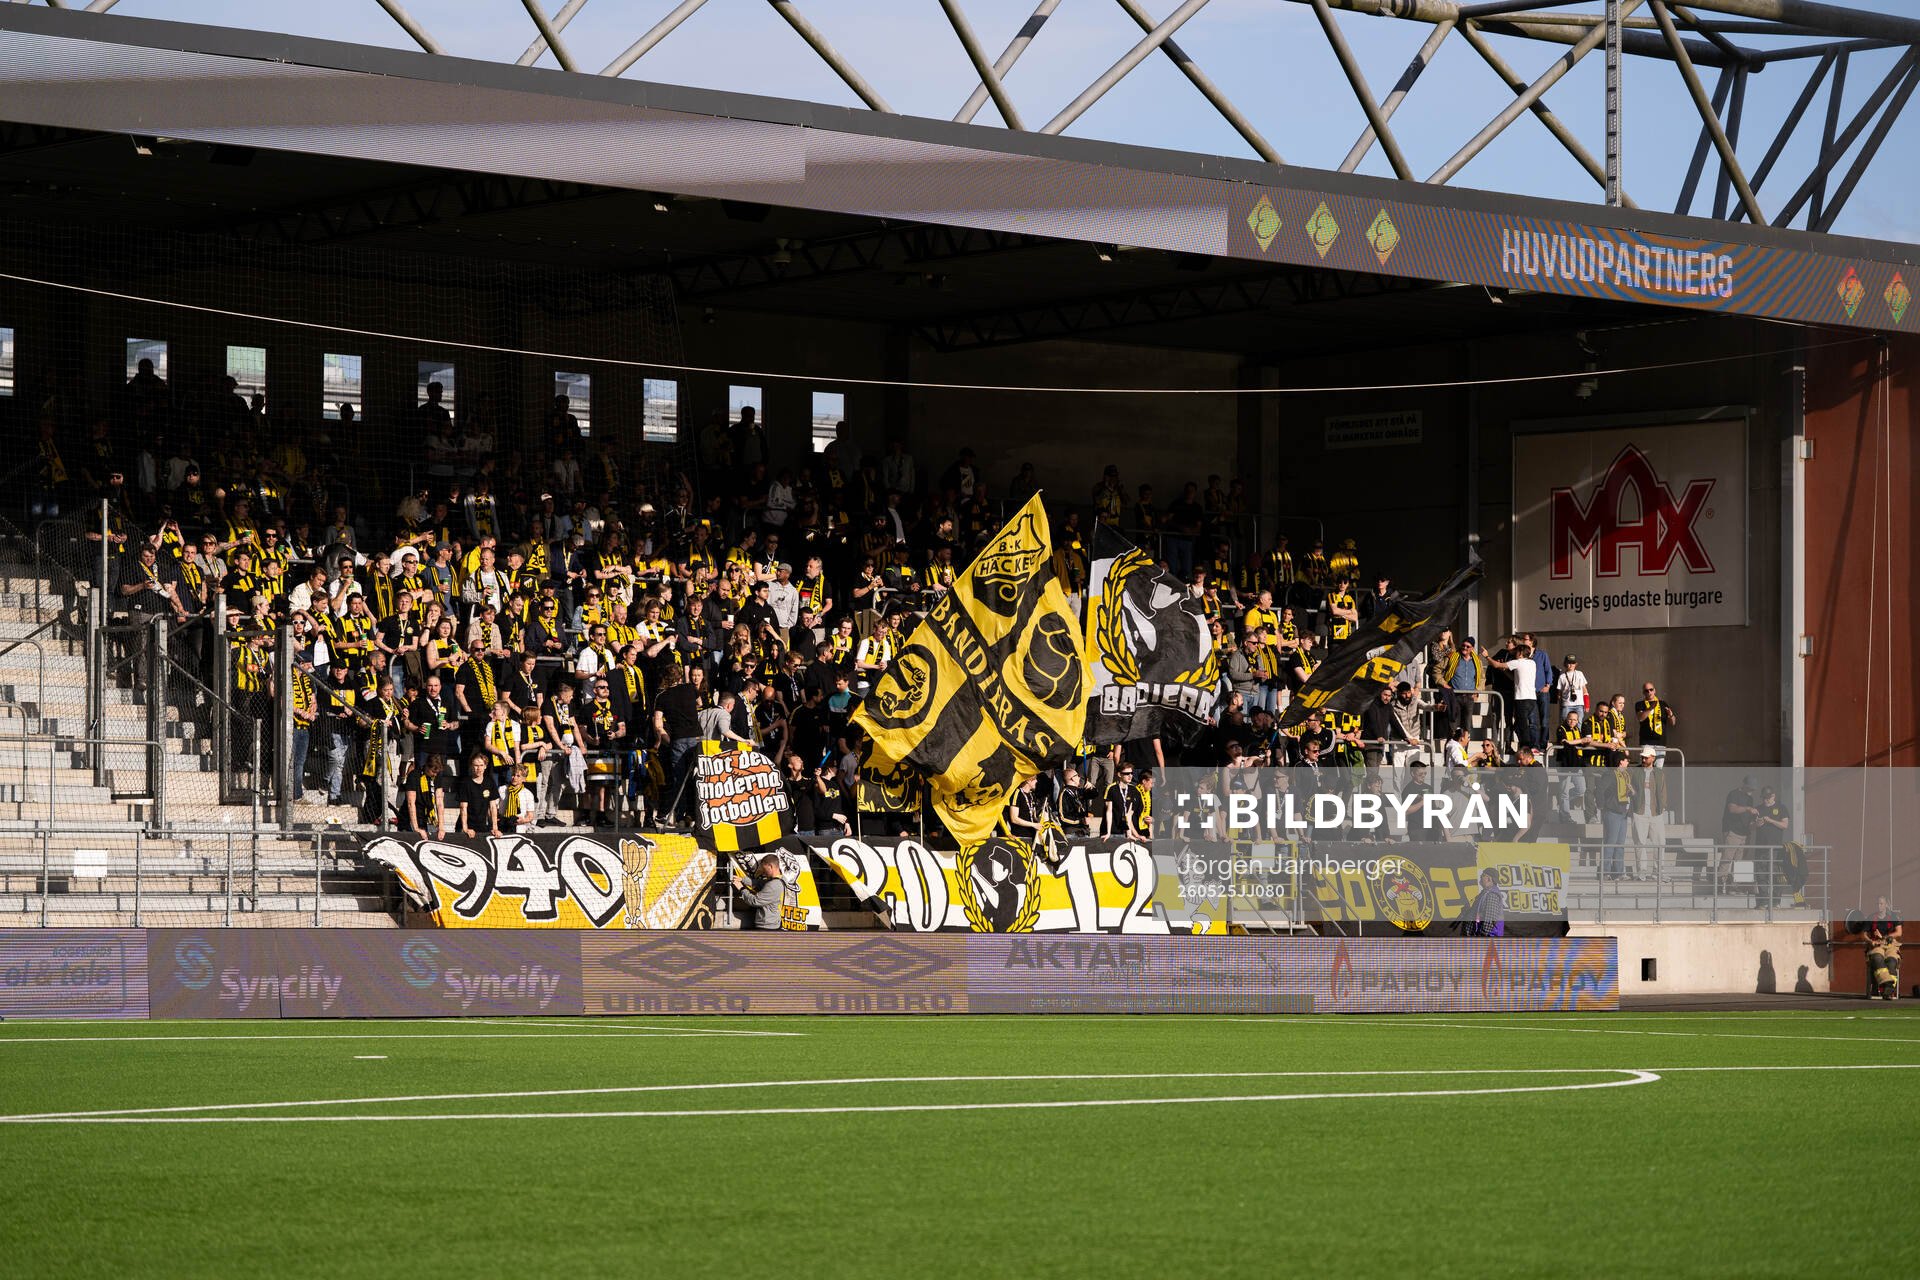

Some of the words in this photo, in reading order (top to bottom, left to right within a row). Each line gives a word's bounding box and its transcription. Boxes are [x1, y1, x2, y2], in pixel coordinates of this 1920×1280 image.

[1503, 228, 1733, 298] HUVUDPARTNERS
[1551, 443, 1716, 580] MAX
[1539, 593, 1600, 613] Sveriges
[1603, 590, 1661, 612] godaste
[1665, 589, 1723, 609] burgare
[698, 771, 781, 801] moderna
[701, 794, 787, 829] fotbollen
[363, 834, 628, 929] 1940
[1499, 863, 1562, 890] SLÄTTA
[1501, 889, 1561, 913] REJECTS
[220, 965, 342, 1011] Syncify
[444, 965, 559, 1010] Syncify
